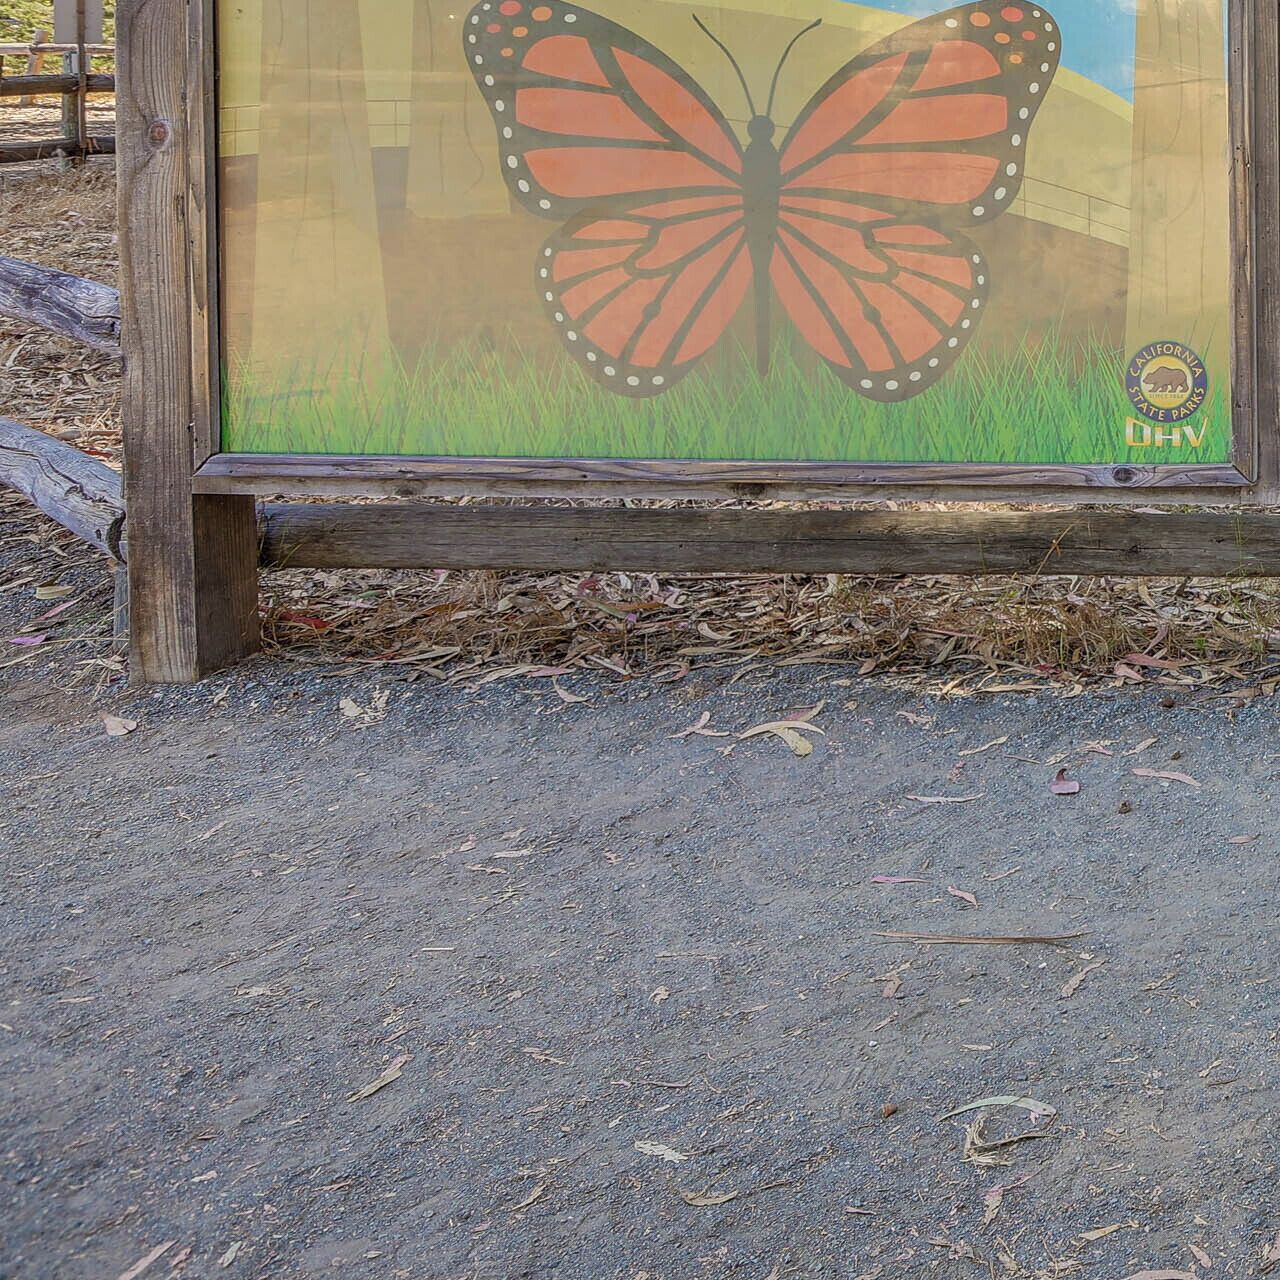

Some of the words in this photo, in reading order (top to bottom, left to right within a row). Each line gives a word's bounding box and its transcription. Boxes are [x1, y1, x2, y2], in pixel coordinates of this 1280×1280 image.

[1129, 343, 1204, 378] CALIFORNIA
[1129, 386, 1166, 421] STATE
[1171, 387, 1205, 421] PARKS
